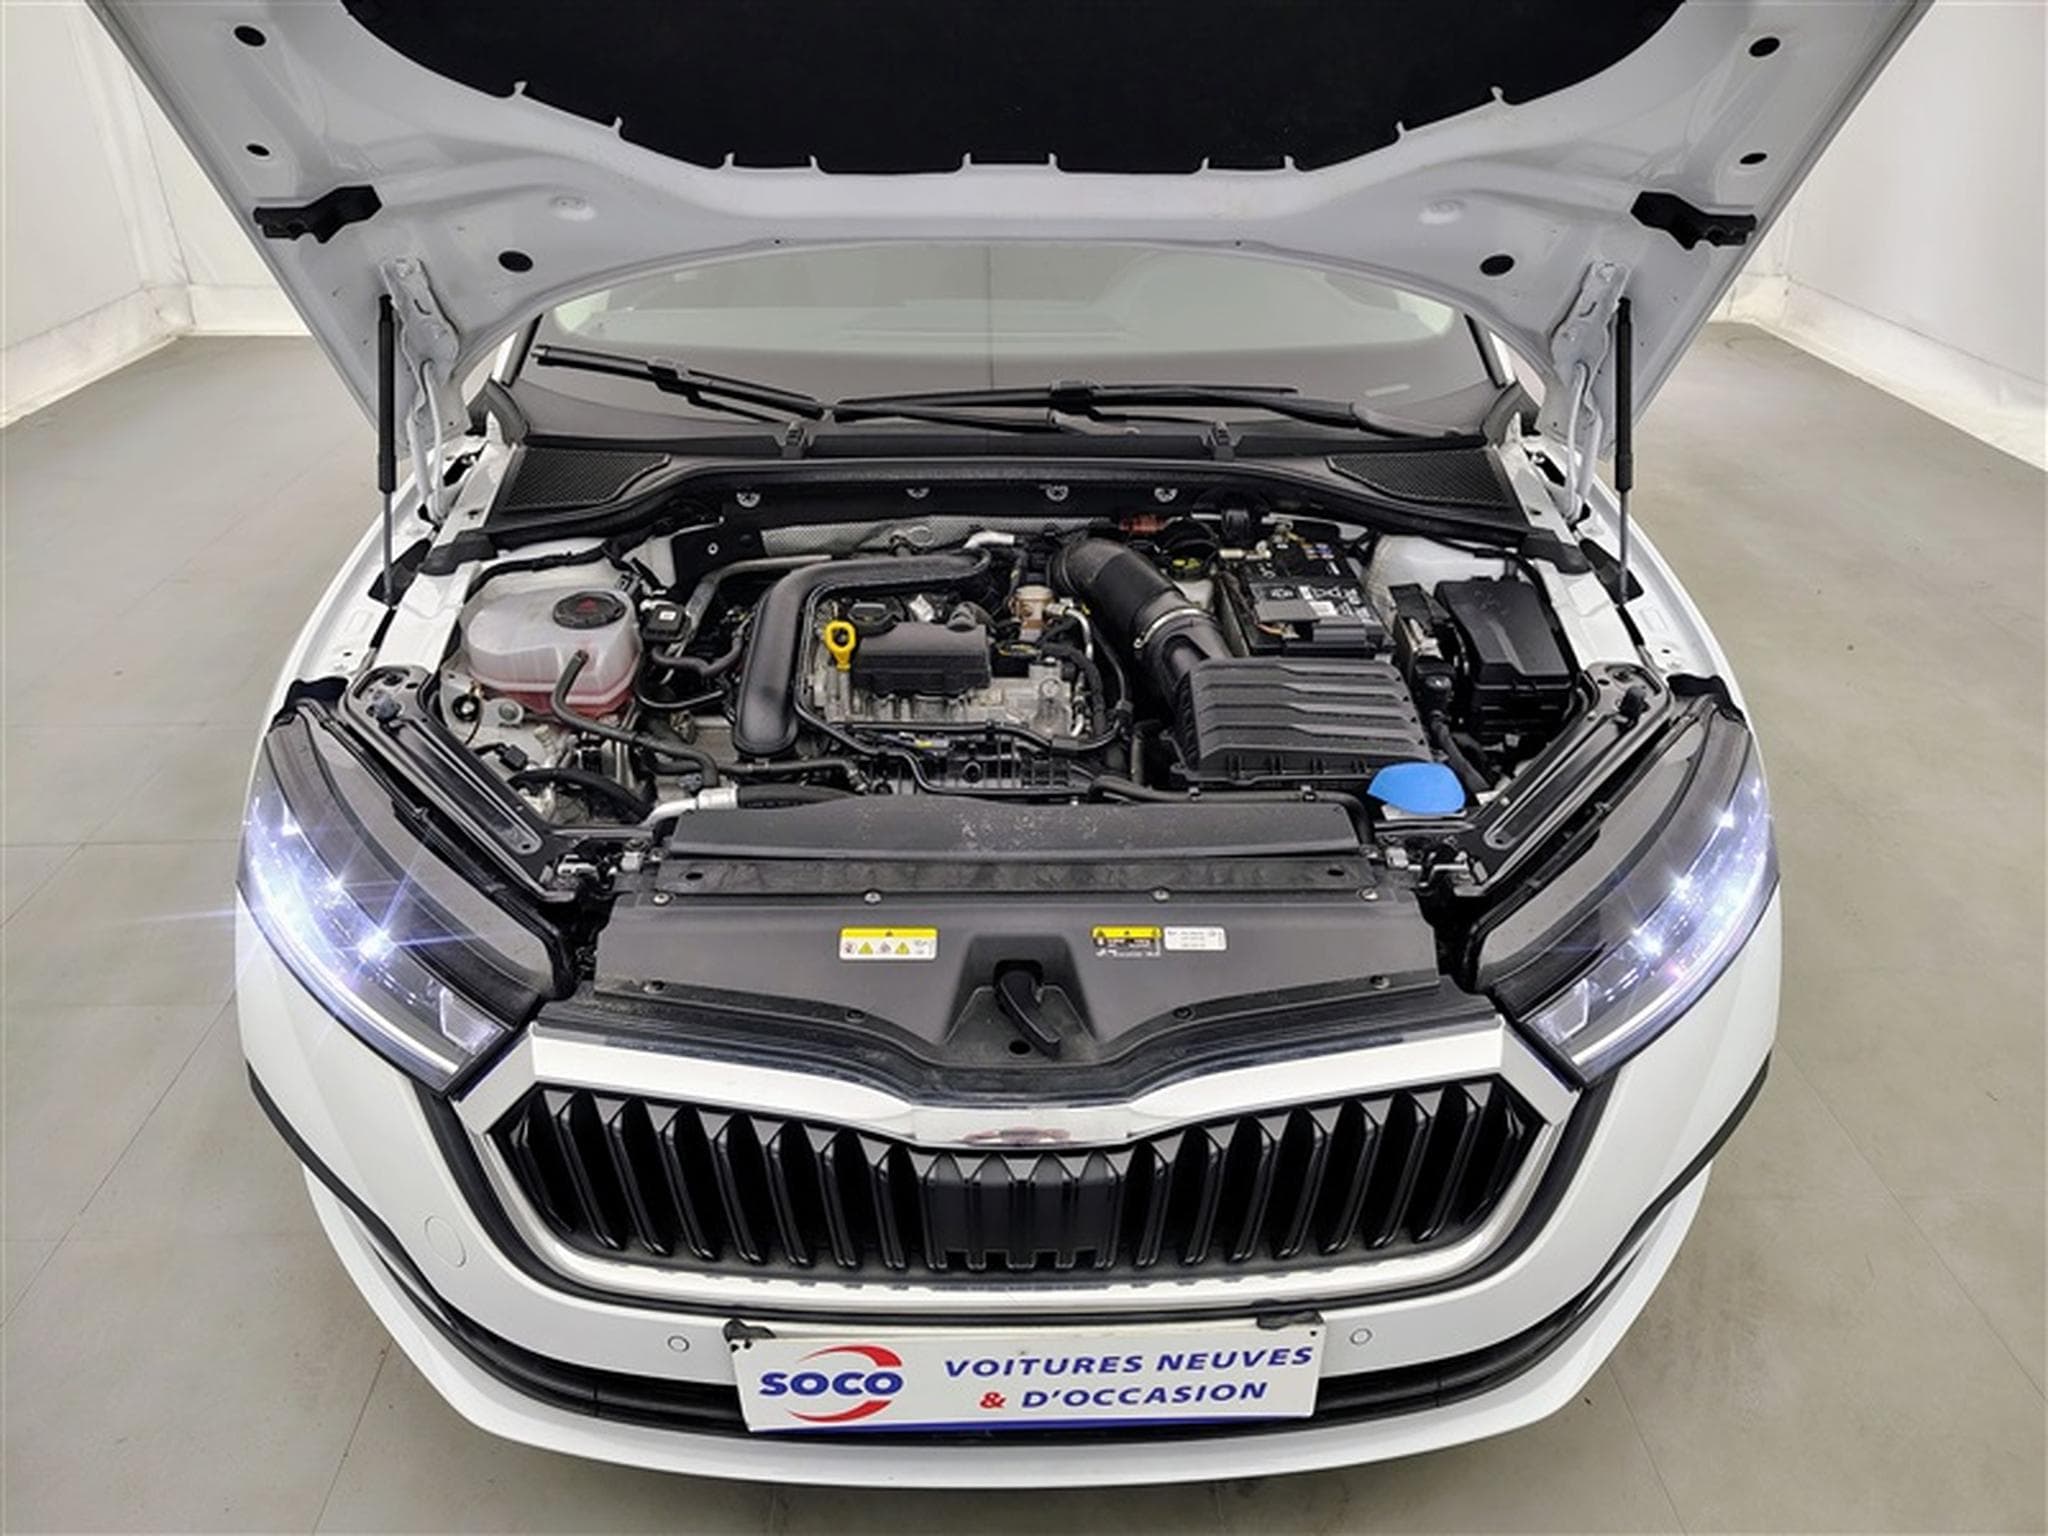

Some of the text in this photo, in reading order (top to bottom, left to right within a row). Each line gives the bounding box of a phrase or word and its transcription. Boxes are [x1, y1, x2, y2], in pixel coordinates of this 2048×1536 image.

[945, 1346, 1314, 1378] VOITURES NEUVES
[759, 1370, 904, 1397] SOCO
[979, 1381, 1267, 1409] & D'OCCASION
